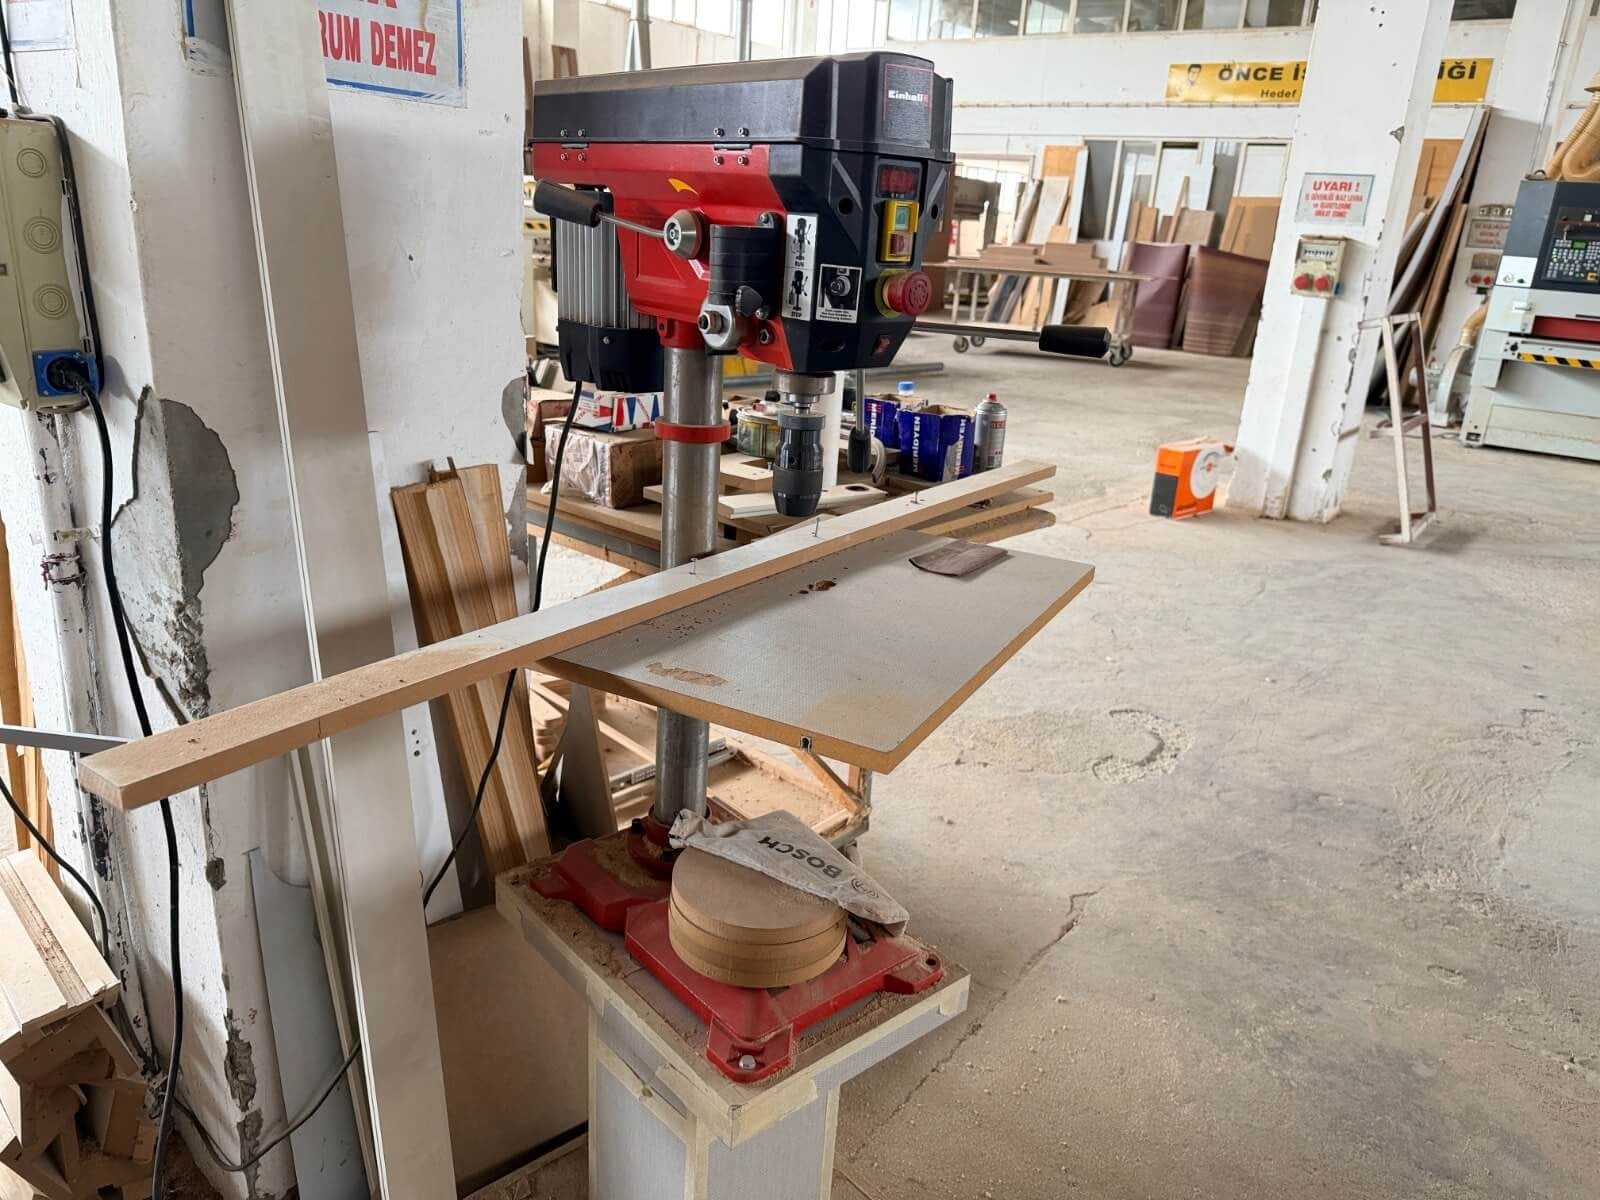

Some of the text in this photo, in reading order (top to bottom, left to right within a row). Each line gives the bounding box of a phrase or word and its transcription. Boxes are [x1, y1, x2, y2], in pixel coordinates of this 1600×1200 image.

[370, 21, 437, 76] DEMEZ
[1218, 64, 1285, 81] ÖNCE
[887, 90, 924, 102] Einhell
[1260, 89, 1297, 98] Hedef
[1313, 181, 1352, 191] UYARI
[756, 836, 843, 879] BOSCH
